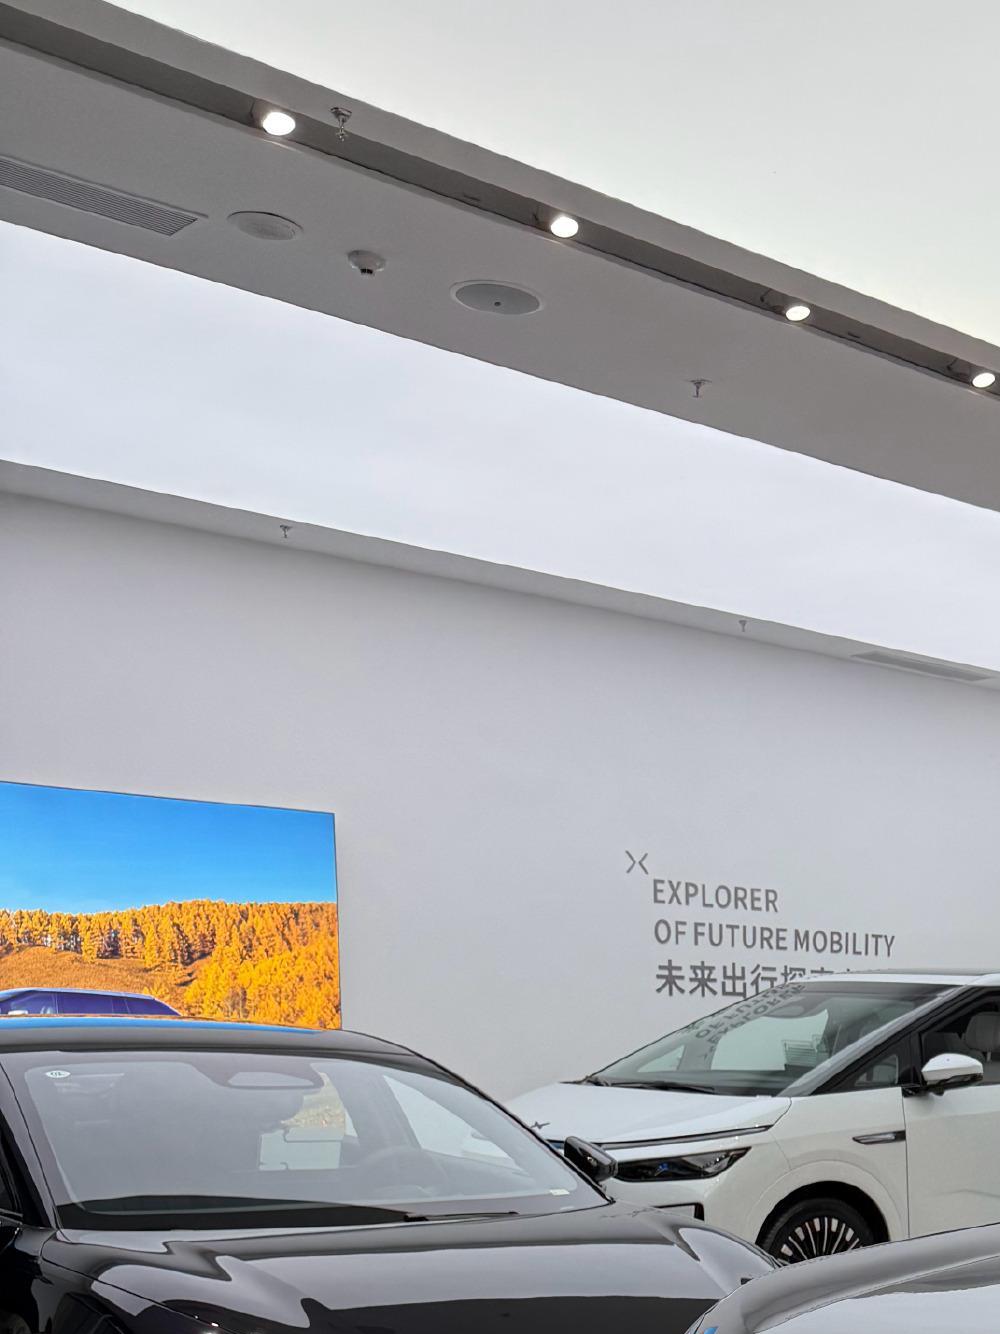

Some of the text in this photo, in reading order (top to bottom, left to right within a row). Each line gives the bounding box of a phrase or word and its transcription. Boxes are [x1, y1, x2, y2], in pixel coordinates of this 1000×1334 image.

[653, 879, 778, 912] EXPLORER
[654, 919, 895, 958] OF FUTURE MOBILITY
